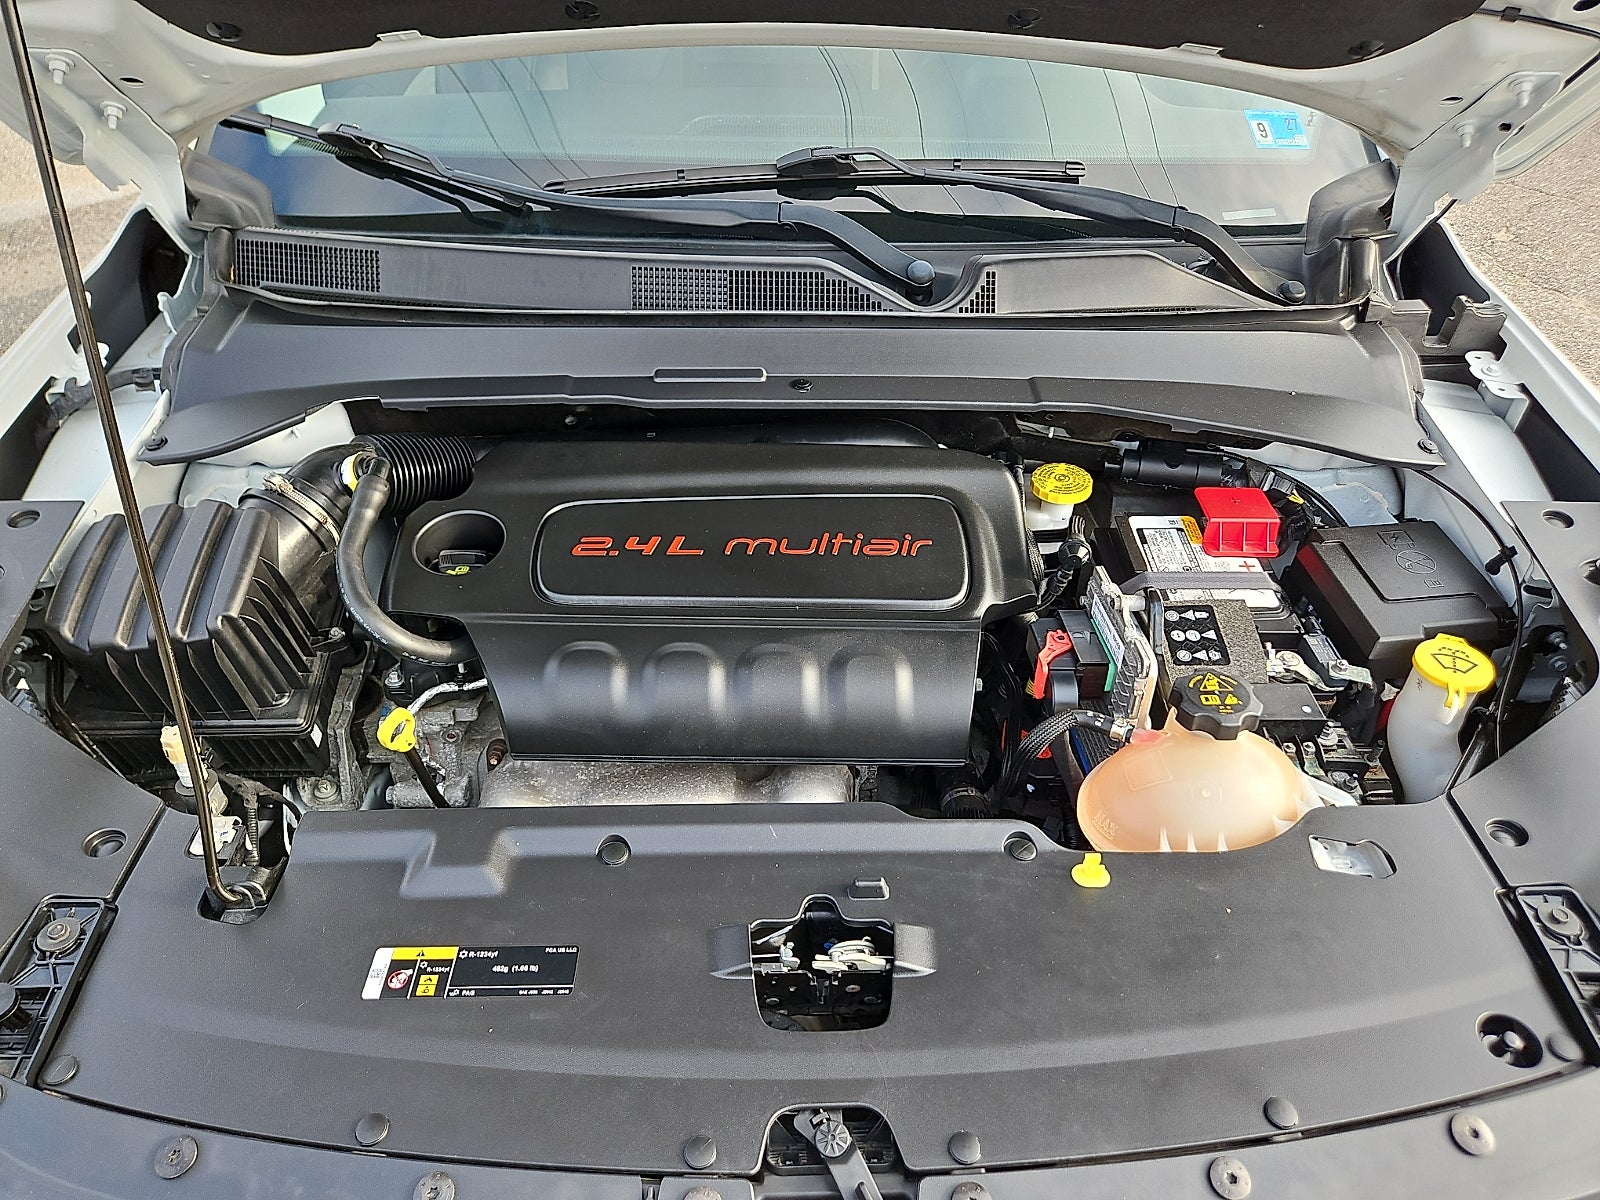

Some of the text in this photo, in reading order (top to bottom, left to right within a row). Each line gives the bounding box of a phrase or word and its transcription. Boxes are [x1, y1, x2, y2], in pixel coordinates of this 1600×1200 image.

[1256, 122, 1268, 138] 9
[1284, 118, 1298, 130] 27
[724, 532, 933, 556] multiair
[1094, 810, 1118, 836] MAX
[468, 950, 499, 959] R-1234yf
[461, 989, 476, 997] PAG
